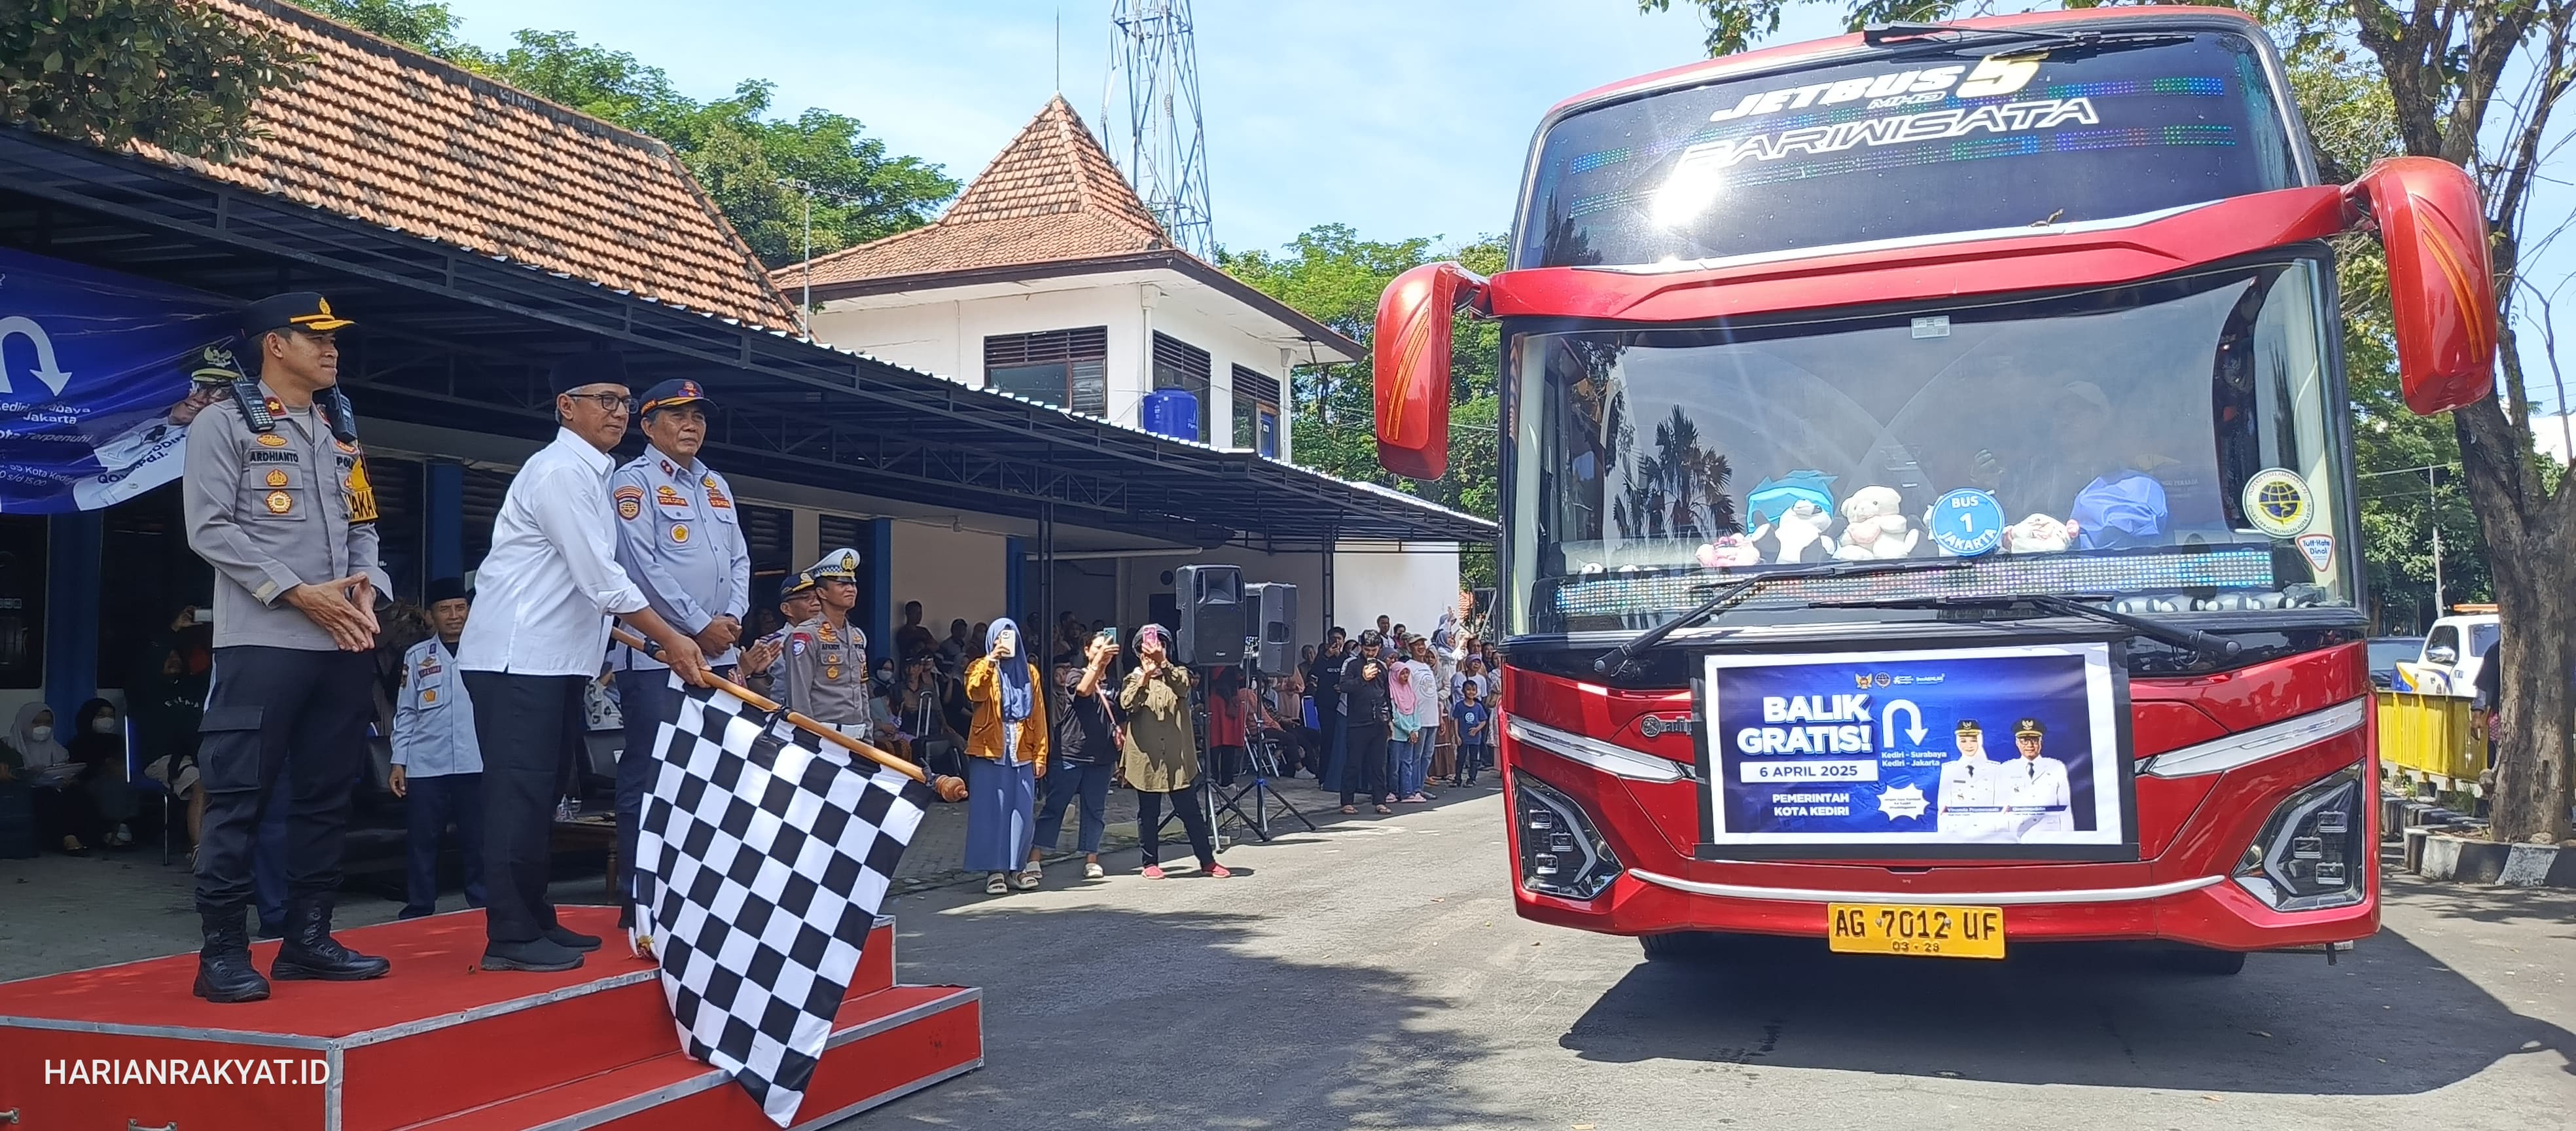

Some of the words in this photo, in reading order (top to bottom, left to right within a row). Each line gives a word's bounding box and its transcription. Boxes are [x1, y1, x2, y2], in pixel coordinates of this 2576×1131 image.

[1709, 65, 1965, 122] JETBUS
[1955, 49, 2051, 98] 5
[0, 400, 30, 412] ediri
[22, 411, 77, 424] Jakarta
[250, 451, 298, 462] ARDHIANTO
[25, 465, 47, 477] Kota
[1951, 495, 1979, 509] BUS
[1959, 512, 1973, 533] 1
[2257, 520, 2298, 534] PERHUBUNGAN
[1937, 528, 1997, 550] JAKARTA
[1763, 694, 1873, 723] BALIK
[1737, 725, 1873, 755] GRATIS!
[1910, 751, 1947, 759] Surabaya
[1759, 766, 1768, 777] 6
[1773, 766, 1816, 777] APRIL
[1821, 765, 1857, 776] 2025
[1772, 793, 1850, 803] PEMERINTAH
[1774, 806, 1808, 816] KOTA
[1810, 806, 1850, 816] KEDIRI
[1835, 910, 1865, 937] AG
[1881, 910, 1950, 939] 7012
[1963, 912, 1998, 941] UF
